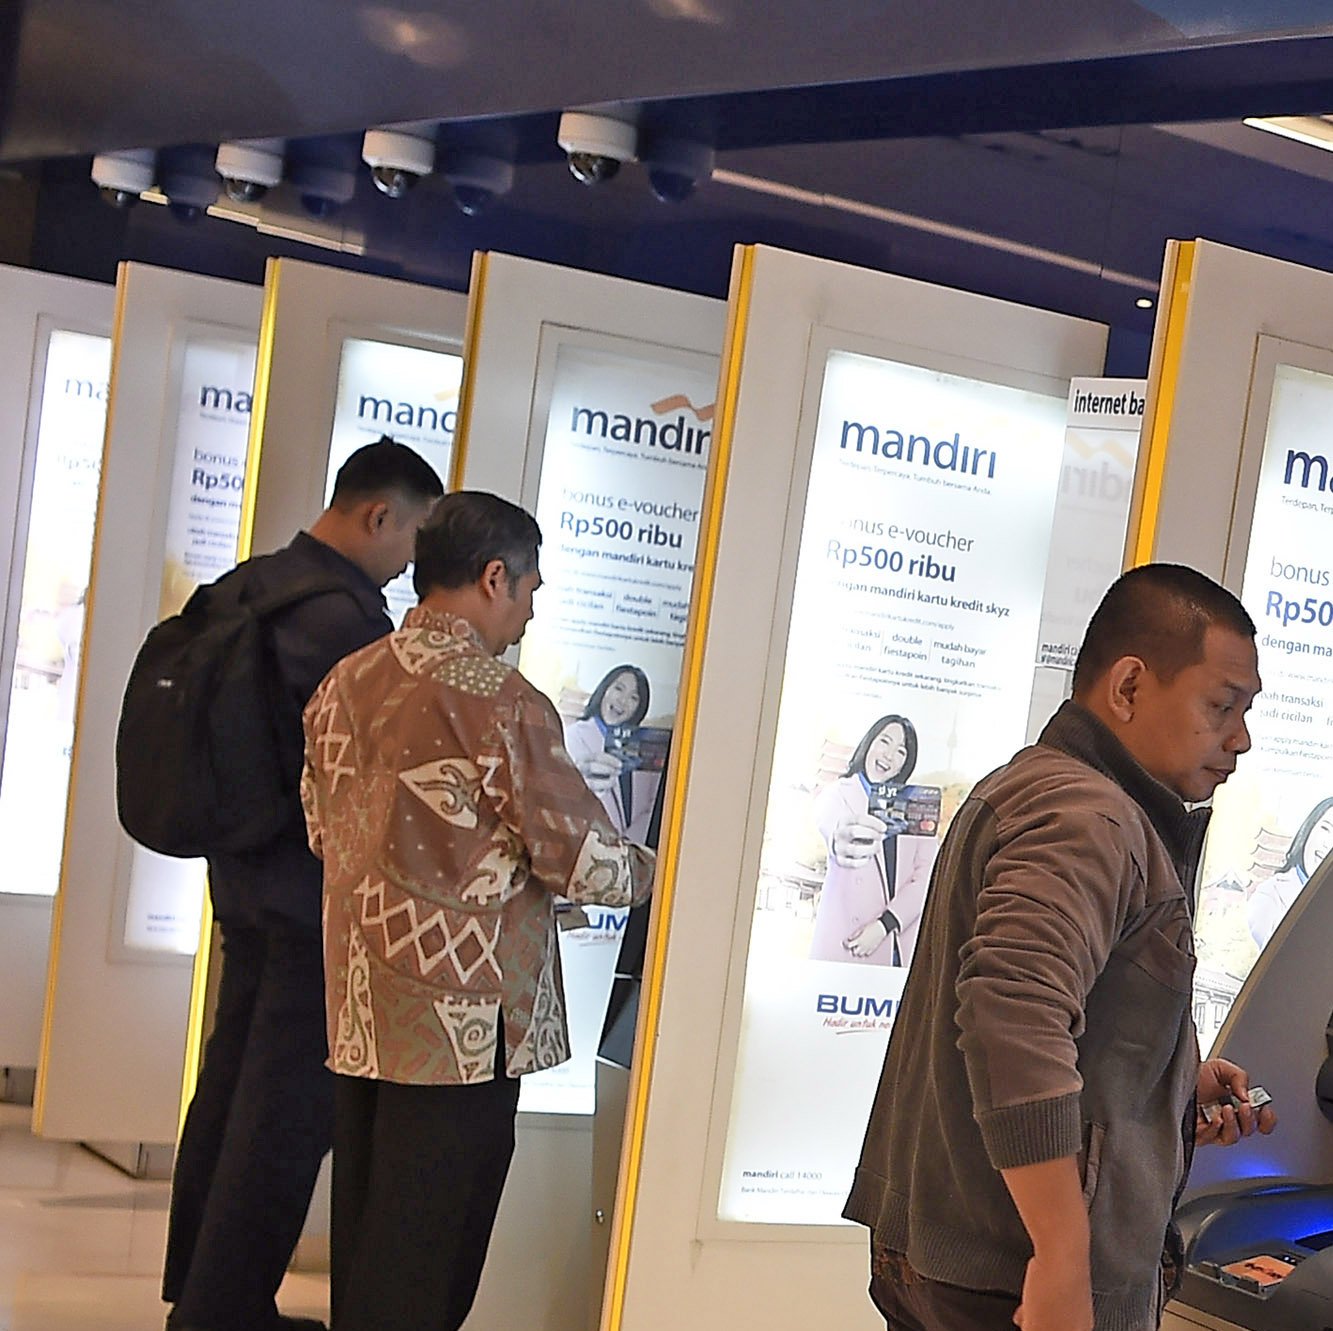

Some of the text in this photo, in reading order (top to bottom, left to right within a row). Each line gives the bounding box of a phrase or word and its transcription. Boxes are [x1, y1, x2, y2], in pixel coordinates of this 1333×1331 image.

[1074, 388, 1126, 415] internet
[840, 419, 997, 478] mandiri
[617, 496, 699, 522] e-voucher
[560, 511, 683, 548] Rp500 ribu
[888, 524, 974, 552] e-voucher
[601, 550, 645, 565] mandiri
[646, 557, 676, 571] kartu
[827, 539, 956, 582] Rp500 ribu
[1270, 556, 1330, 588] bonus
[869, 583, 1011, 618] mandiri kartu kredit skyz
[892, 634, 923, 646] double
[1261, 635, 1309, 656] dengan
[816, 994, 899, 1016] BUM
[742, 1169, 778, 1179] mandiri
